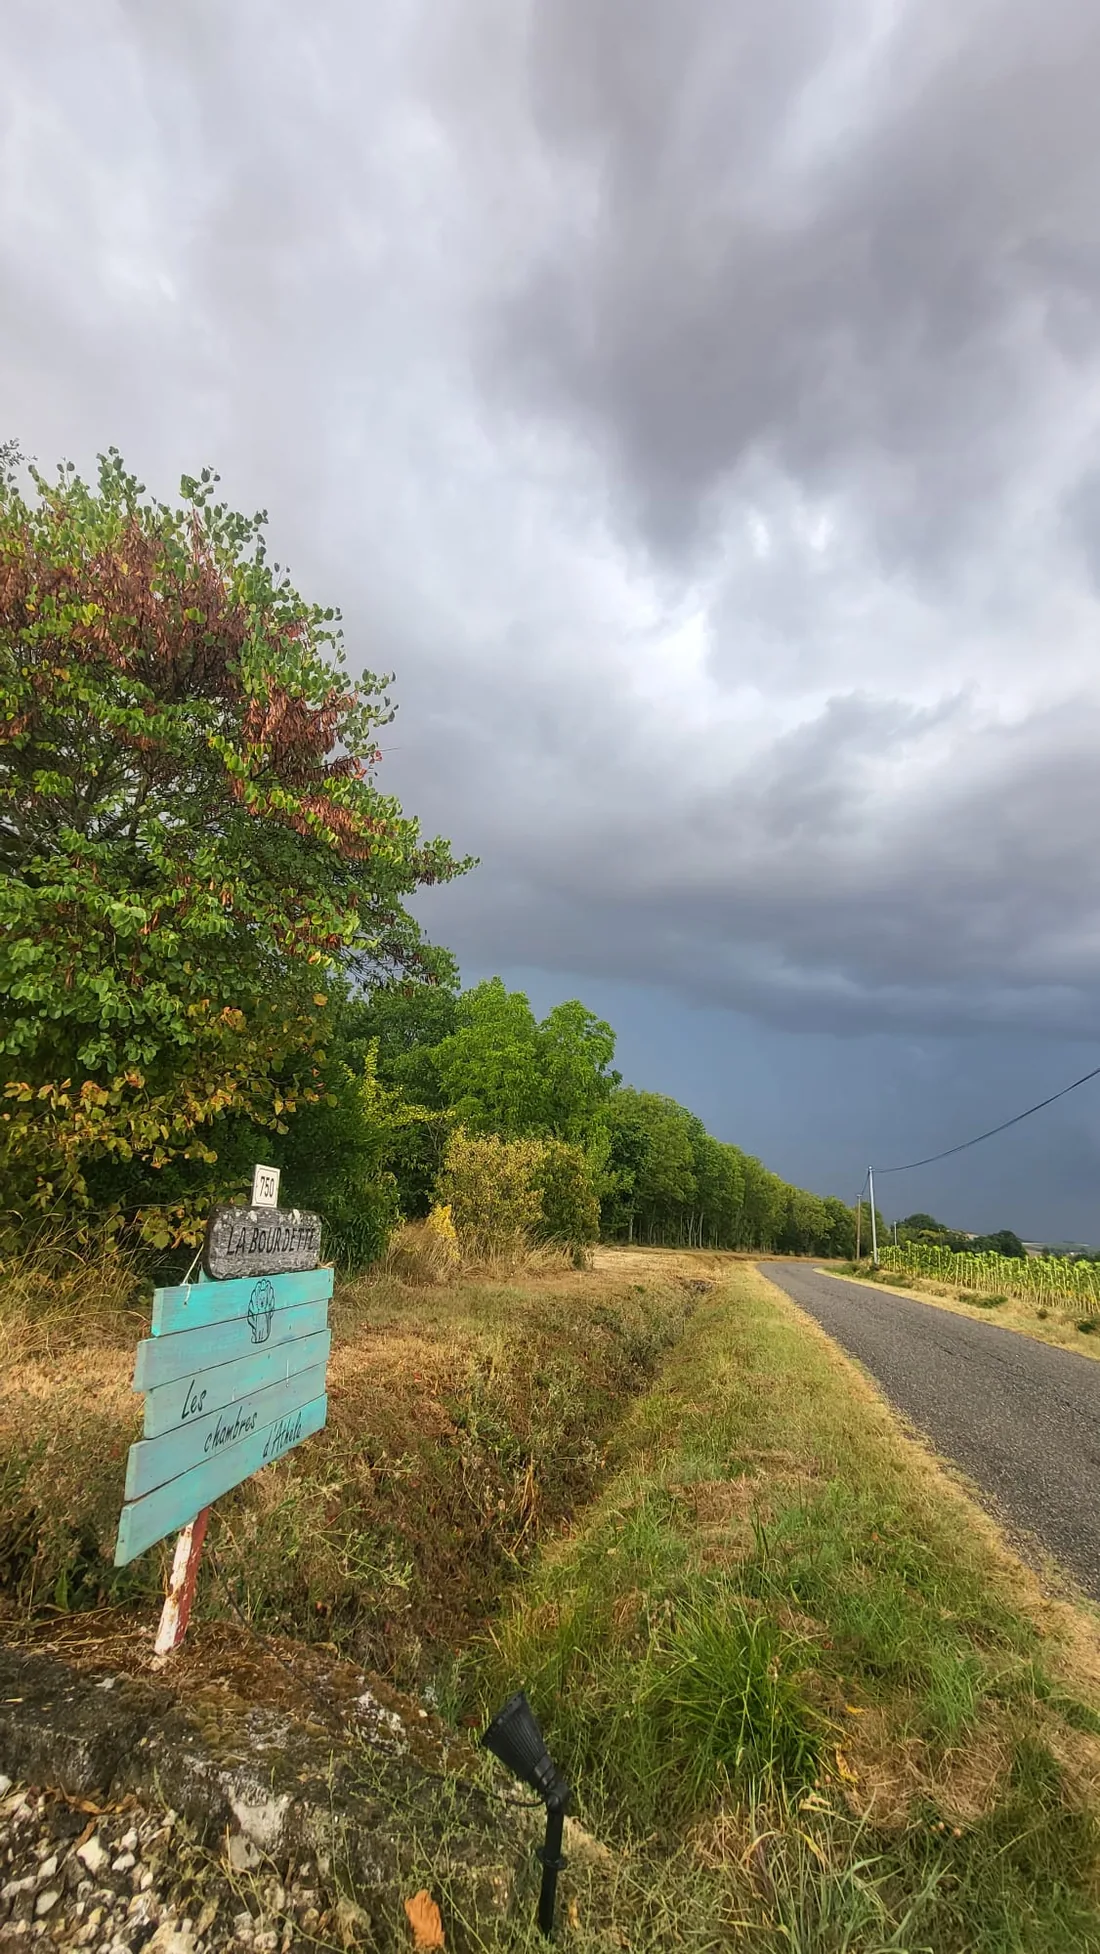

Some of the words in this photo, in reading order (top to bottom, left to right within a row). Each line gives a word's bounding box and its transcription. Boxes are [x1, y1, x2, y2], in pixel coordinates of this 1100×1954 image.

[259, 1176, 275, 1198] 750
[226, 1226, 246, 1256] LA
[248, 1226, 316, 1254] BOURDETTE
[181, 1379, 207, 1420] Les
[204, 1406, 258, 1453] chambres
